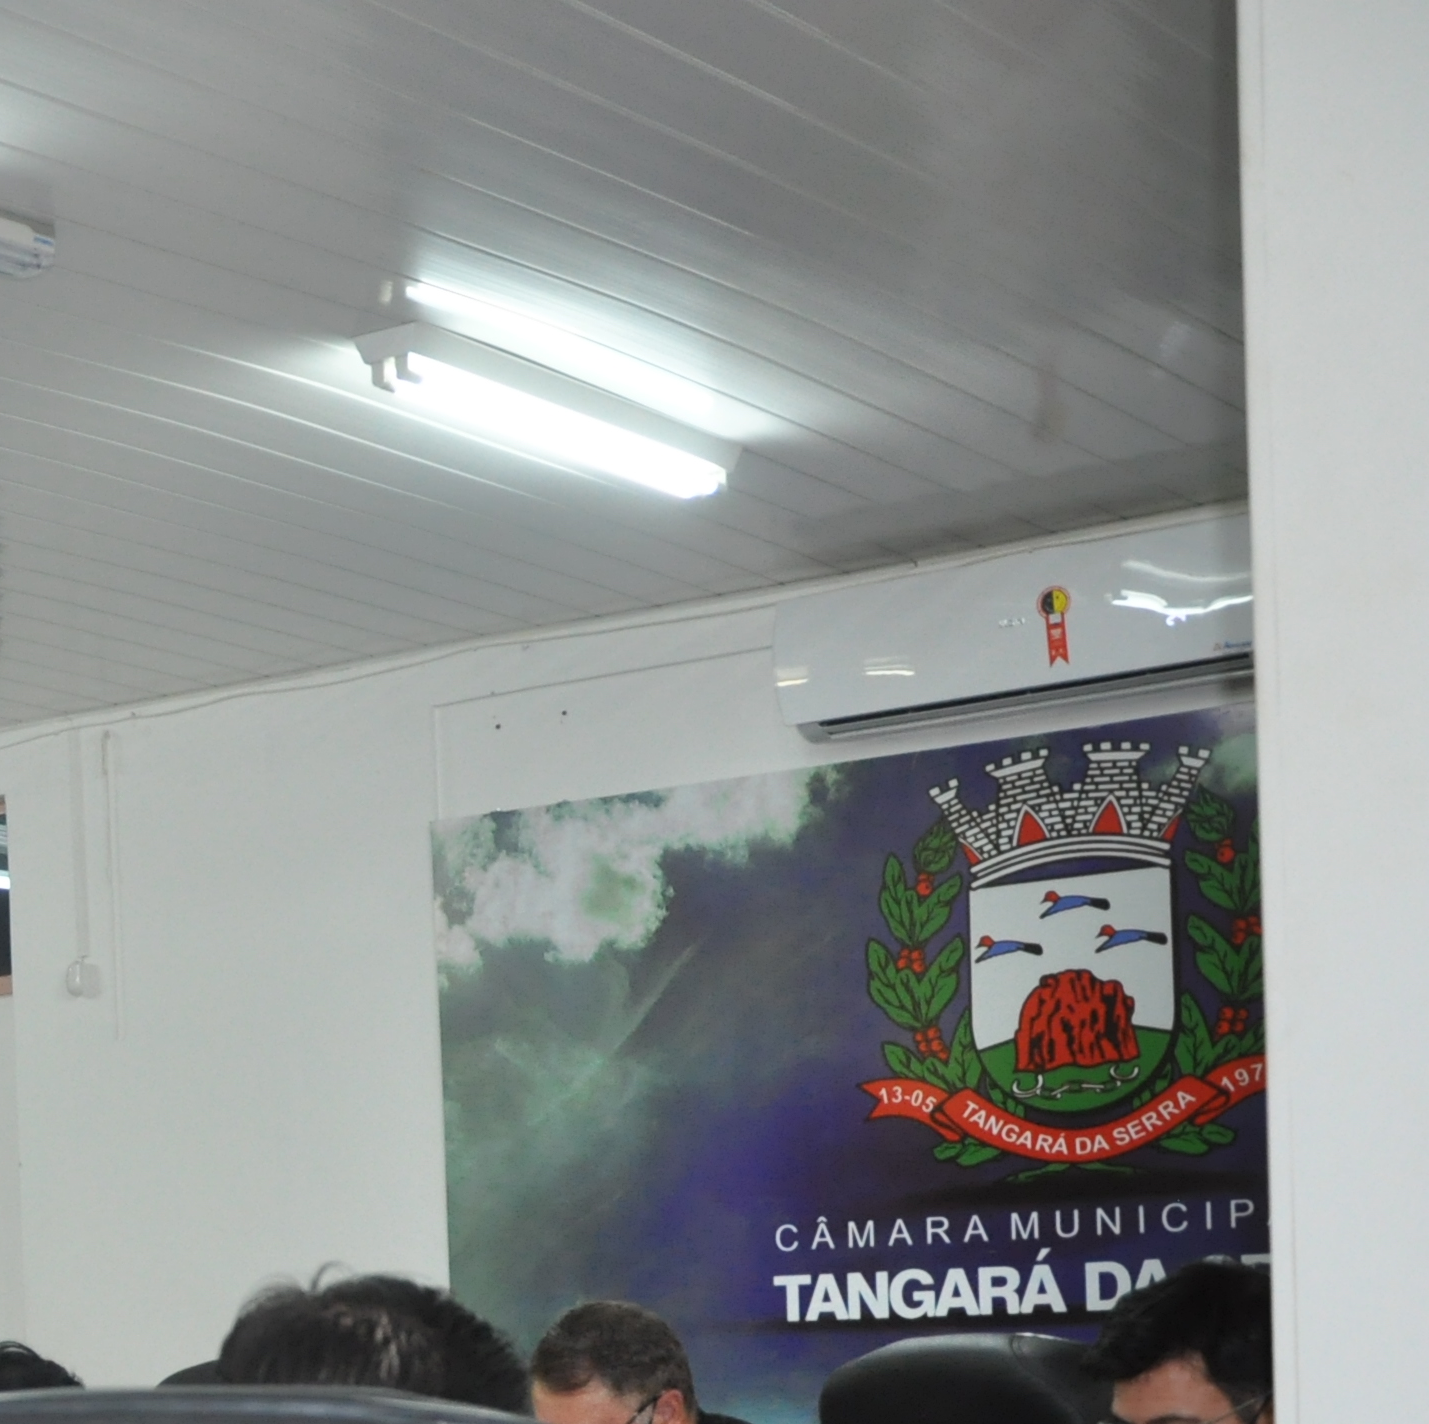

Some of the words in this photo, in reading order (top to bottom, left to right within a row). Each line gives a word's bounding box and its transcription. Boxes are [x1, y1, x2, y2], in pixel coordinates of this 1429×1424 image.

[879, 1087, 937, 1113] 13-05
[961, 1101, 1068, 1156] TANGARÁ
[1075, 1135, 1110, 1156] DA
[1111, 1089, 1197, 1148] SERRA
[774, 1216, 990, 1252] CÂMARA
[773, 1248, 1067, 1323] TANGARÁ
